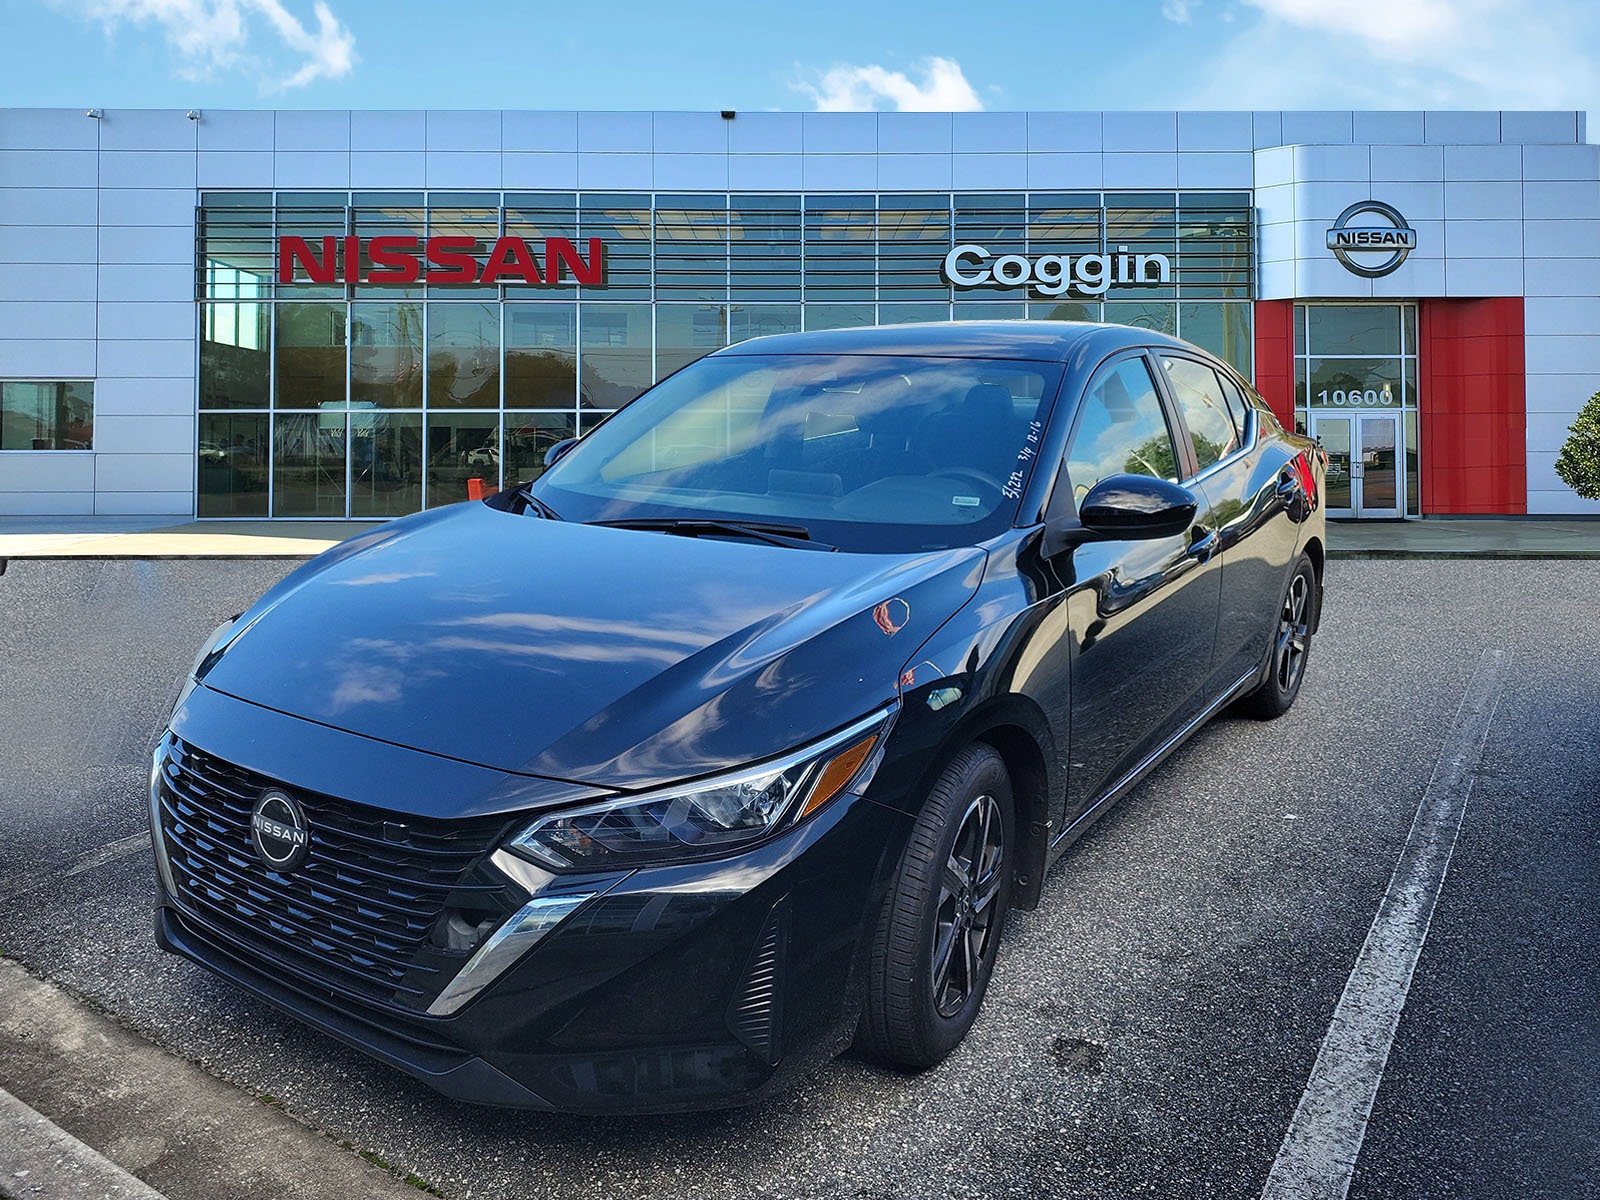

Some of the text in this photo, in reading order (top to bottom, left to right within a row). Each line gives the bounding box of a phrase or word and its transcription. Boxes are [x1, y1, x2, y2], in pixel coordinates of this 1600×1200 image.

[1336, 231, 1409, 245] NISSAN
[279, 236, 602, 284] NISSAN
[944, 244, 1171, 295] Coggin
[1317, 389, 1394, 406] 10600
[252, 815, 305, 844] NISSAN
